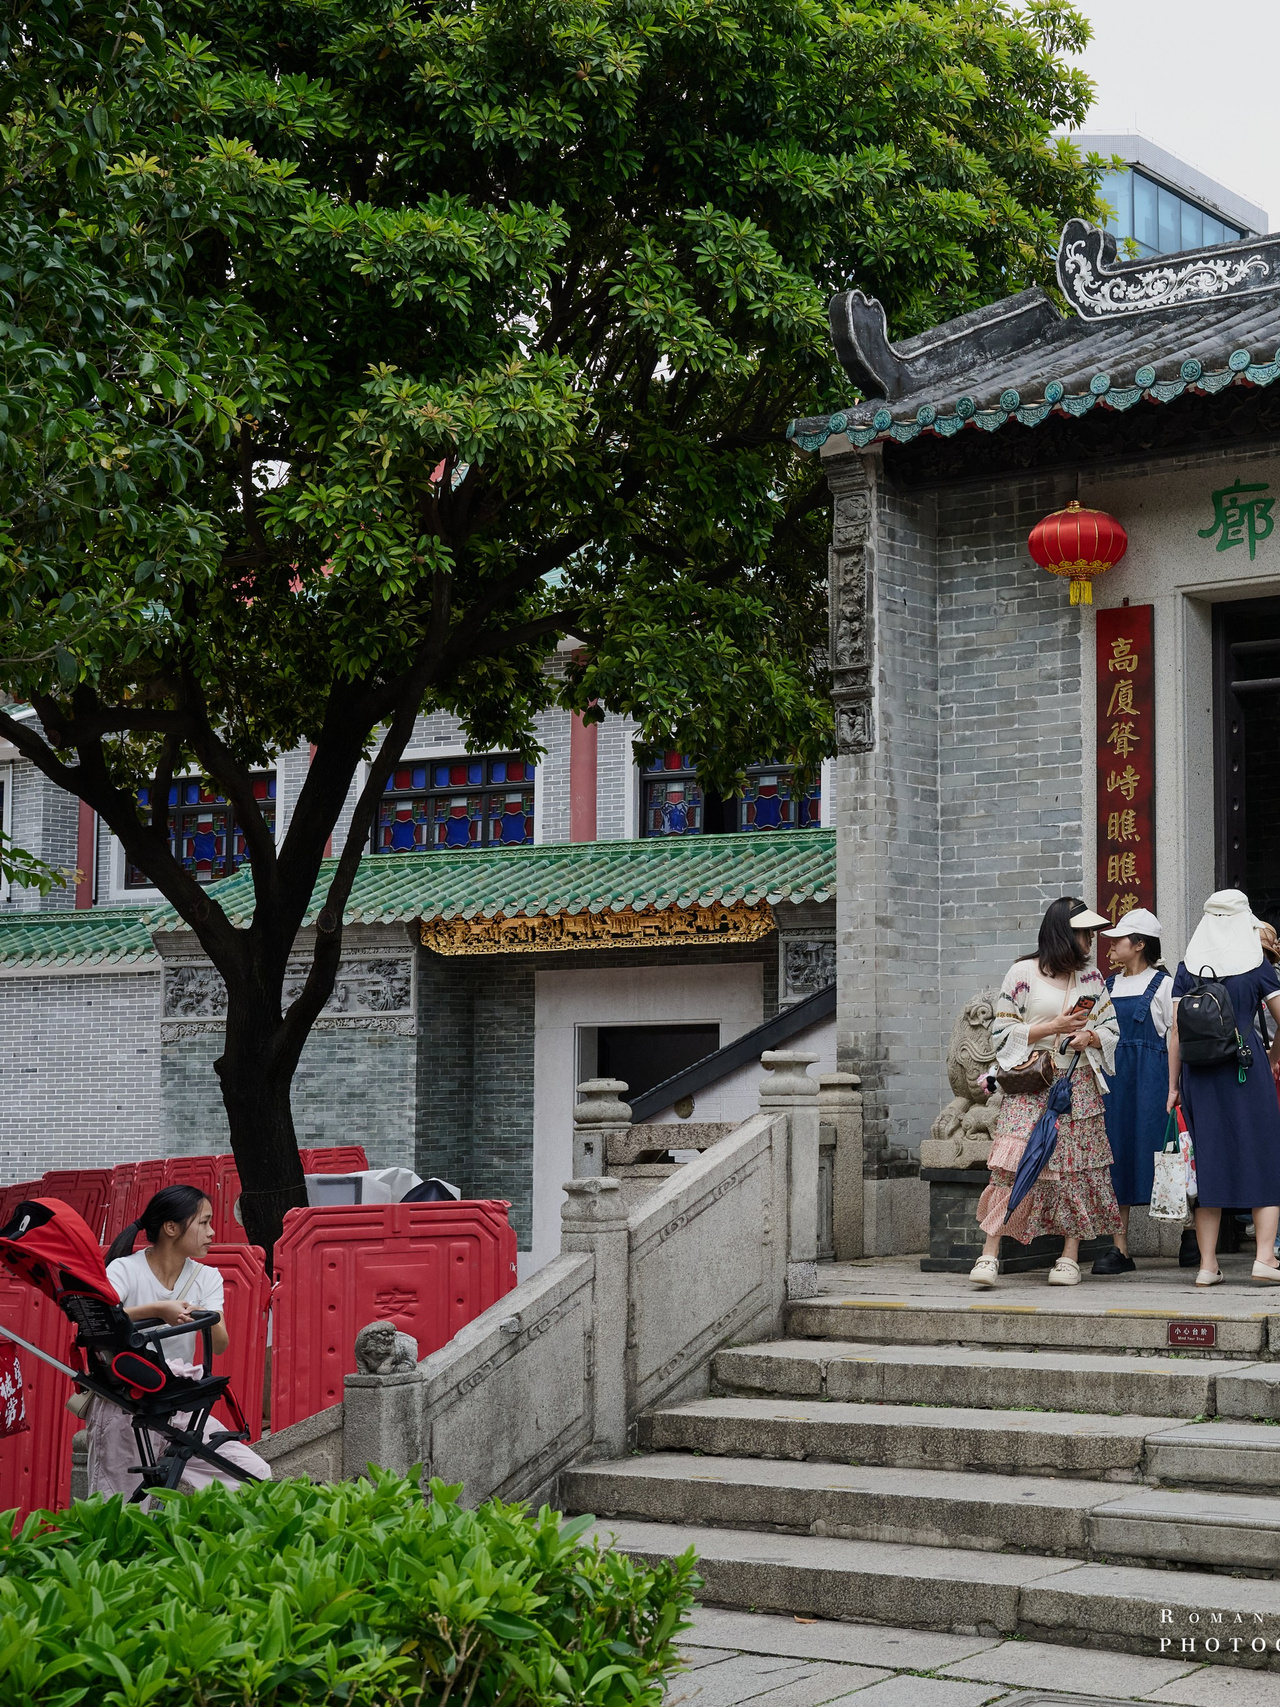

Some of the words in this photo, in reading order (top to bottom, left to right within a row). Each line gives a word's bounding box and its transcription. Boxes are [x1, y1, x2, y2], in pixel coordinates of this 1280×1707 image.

[1106, 637, 1141, 972] 高廈聳峙瞧瞧佛
[374, 1288, 418, 1320] 安
[1174, 1327, 1207, 1335] 小心台阶
